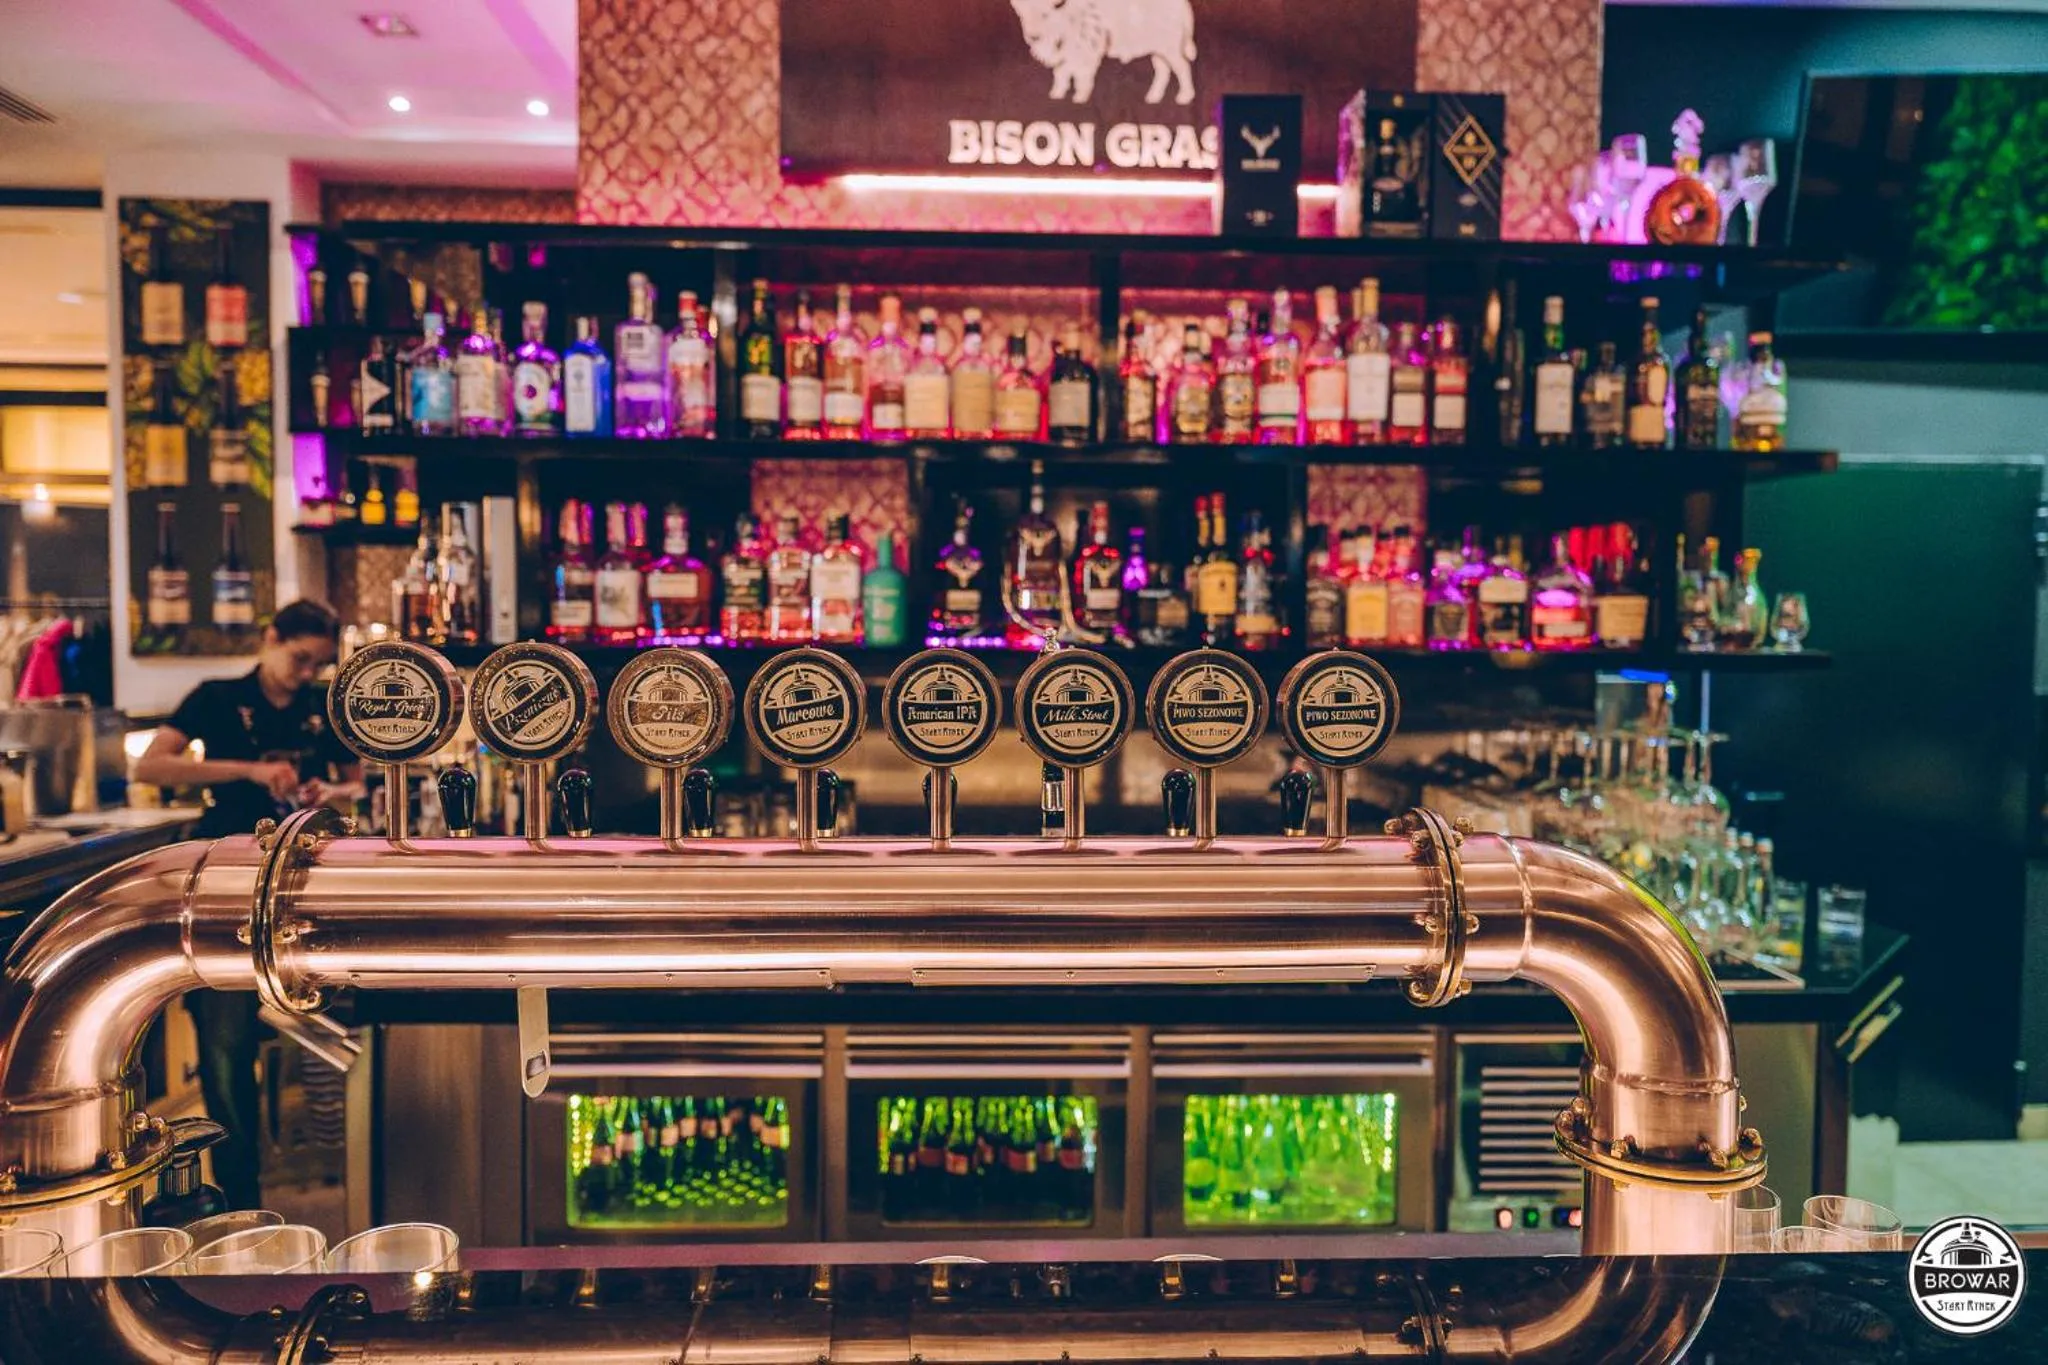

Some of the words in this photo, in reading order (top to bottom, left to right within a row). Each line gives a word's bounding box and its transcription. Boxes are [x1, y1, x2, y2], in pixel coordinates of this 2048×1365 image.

[948, 119, 1096, 166] BISON
[651, 704, 685, 721] Pils
[776, 703, 835, 726] Marcowe
[907, 705, 954, 720] American
[956, 704, 977, 720] IPA
[1042, 705, 1077, 723] Milk
[1078, 706, 1109, 721] Stout
[1173, 704, 1196, 719] PIWO
[1197, 706, 1245, 718] SEZONOWE
[1306, 710, 1330, 722] PIWO
[1330, 708, 1377, 721] SEZONOWE
